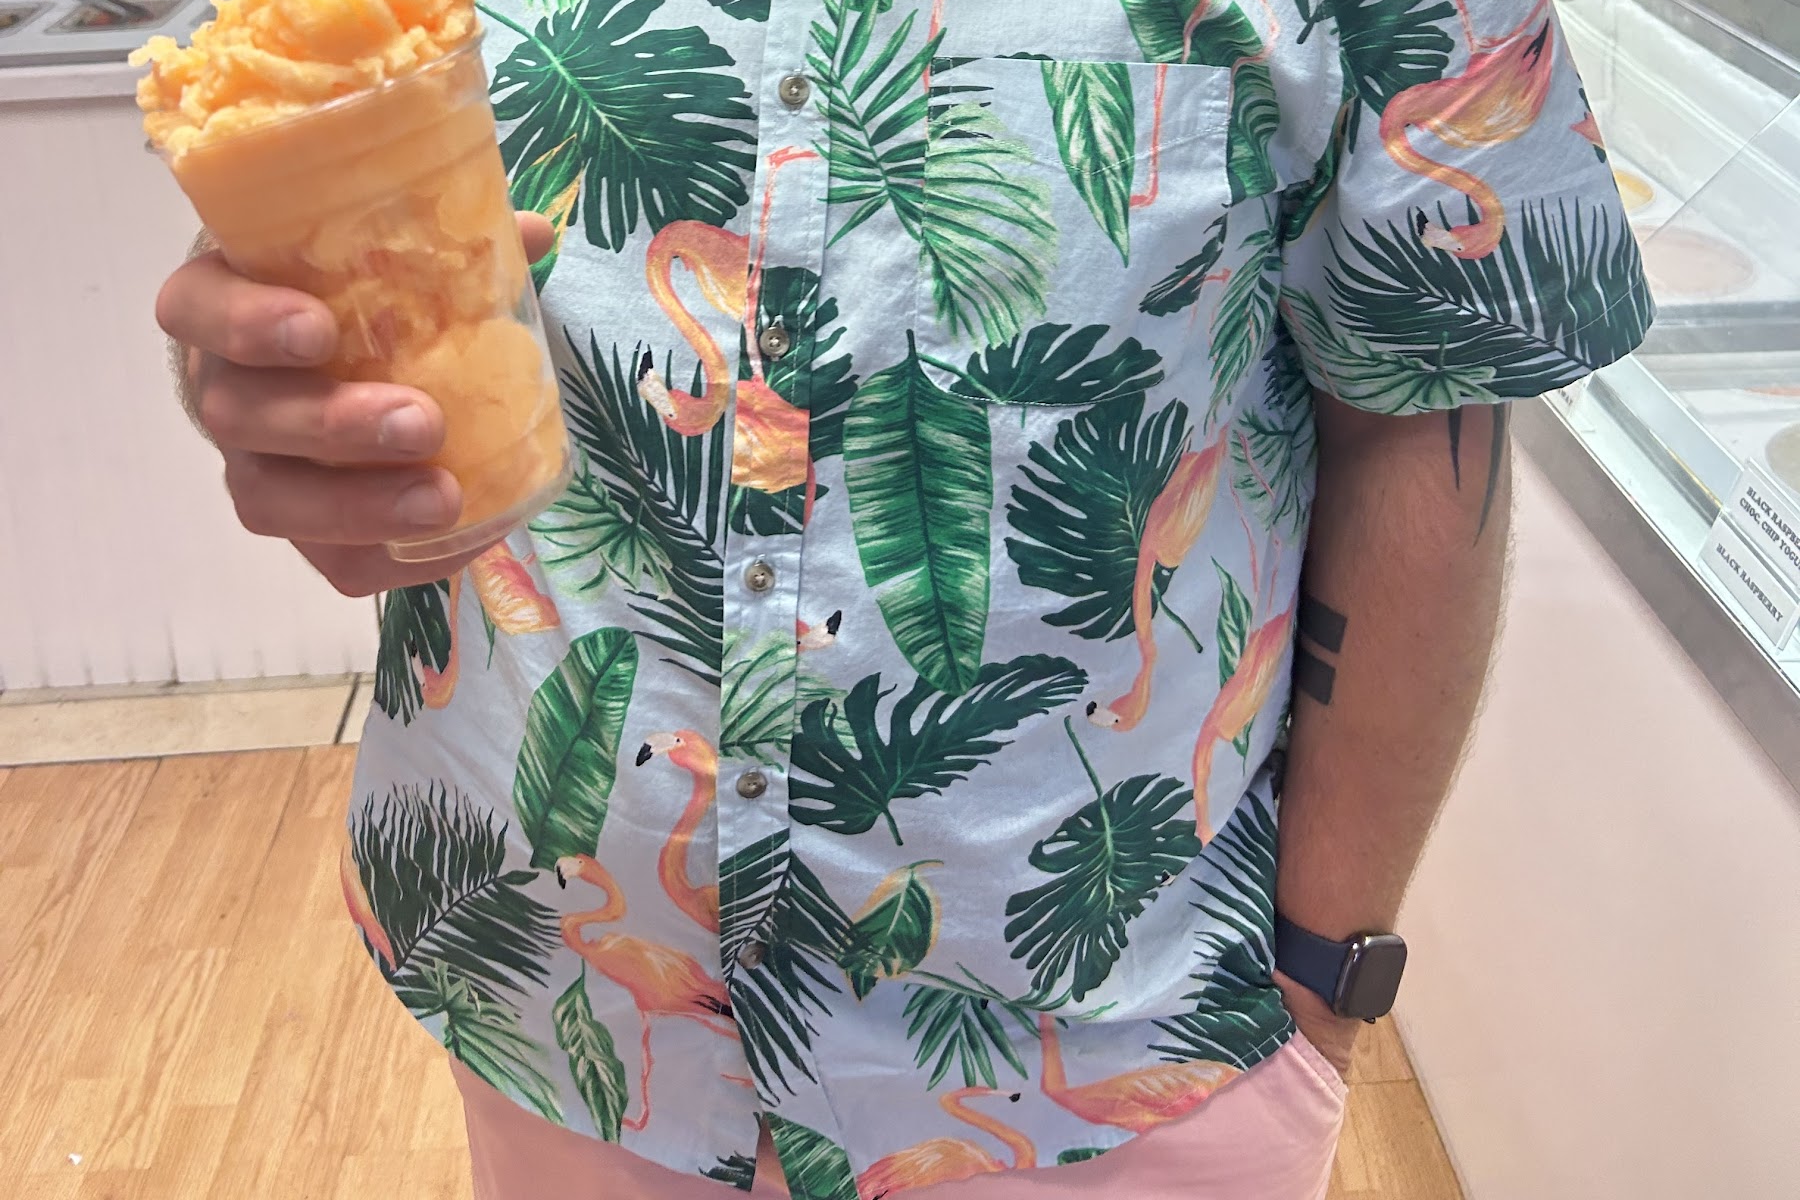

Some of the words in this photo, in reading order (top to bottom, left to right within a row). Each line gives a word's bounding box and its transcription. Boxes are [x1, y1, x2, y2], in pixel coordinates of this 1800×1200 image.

[1746, 486, 1773, 517] BLACK
[1761, 521, 1780, 542] CHIP
[1779, 539, 1800, 570] YOGU
[1716, 543, 1741, 574] BLACK
[1740, 569, 1783, 622] RASPBERRY
